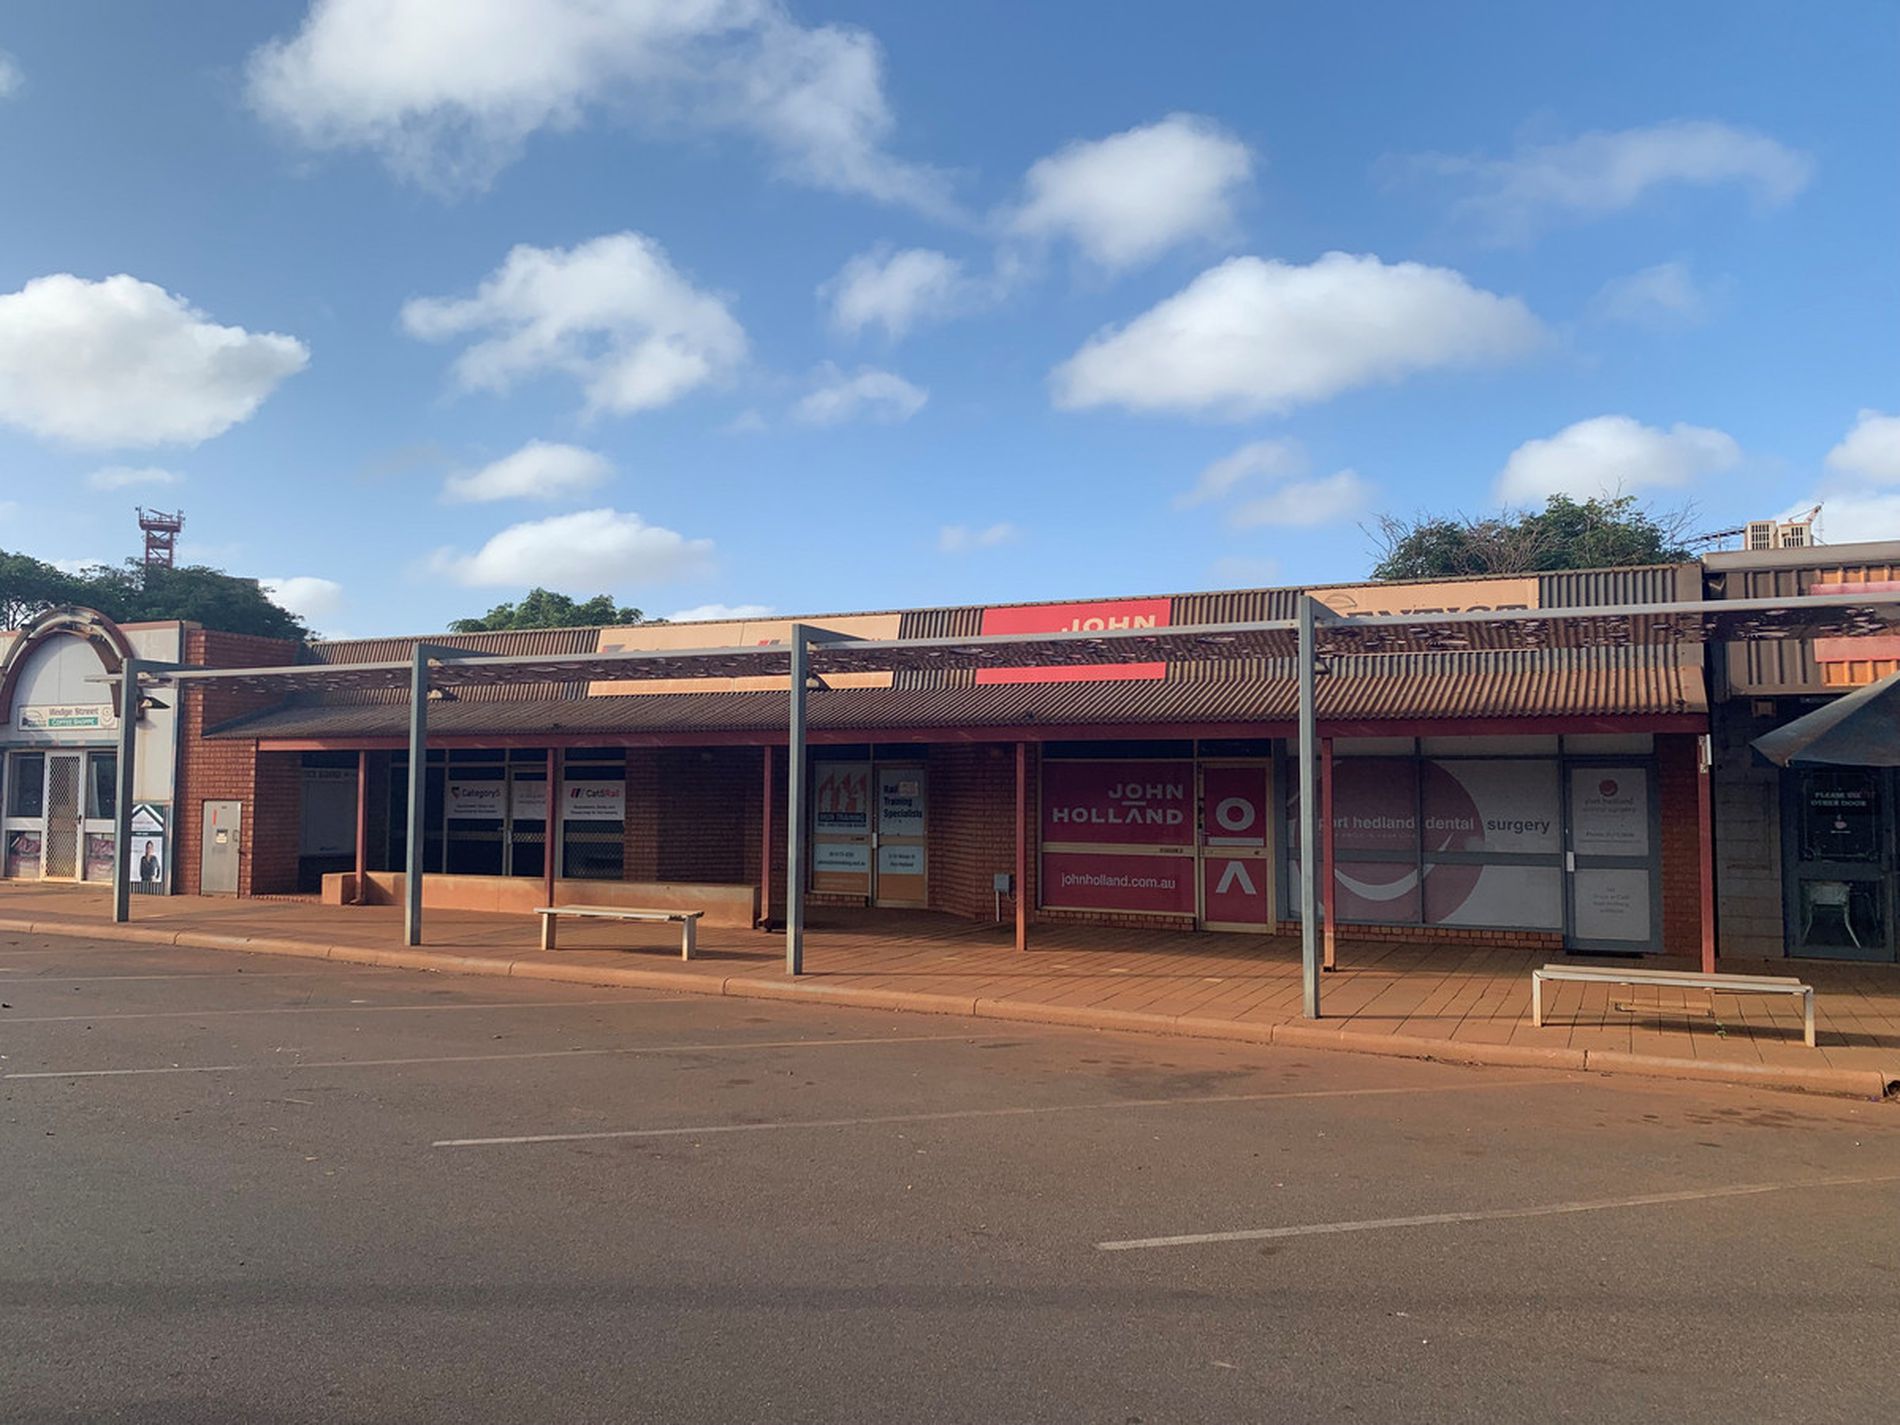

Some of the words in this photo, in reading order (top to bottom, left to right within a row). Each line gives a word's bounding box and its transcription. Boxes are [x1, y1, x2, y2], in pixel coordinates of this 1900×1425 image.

[1061, 614, 1157, 632] JOHN
[75, 706, 99, 716] Street
[1107, 783, 1184, 799] JOHN
[883, 796, 913, 807] Training
[882, 808, 923, 819] Specialists
[1051, 807, 1185, 825] HOLLAND
[1318, 815, 1348, 831] prt
[1353, 815, 1416, 830] hedland
[1425, 815, 1475, 831] dental
[1487, 817, 1551, 835] surgery
[1061, 872, 1177, 889] johnholland.com.au
